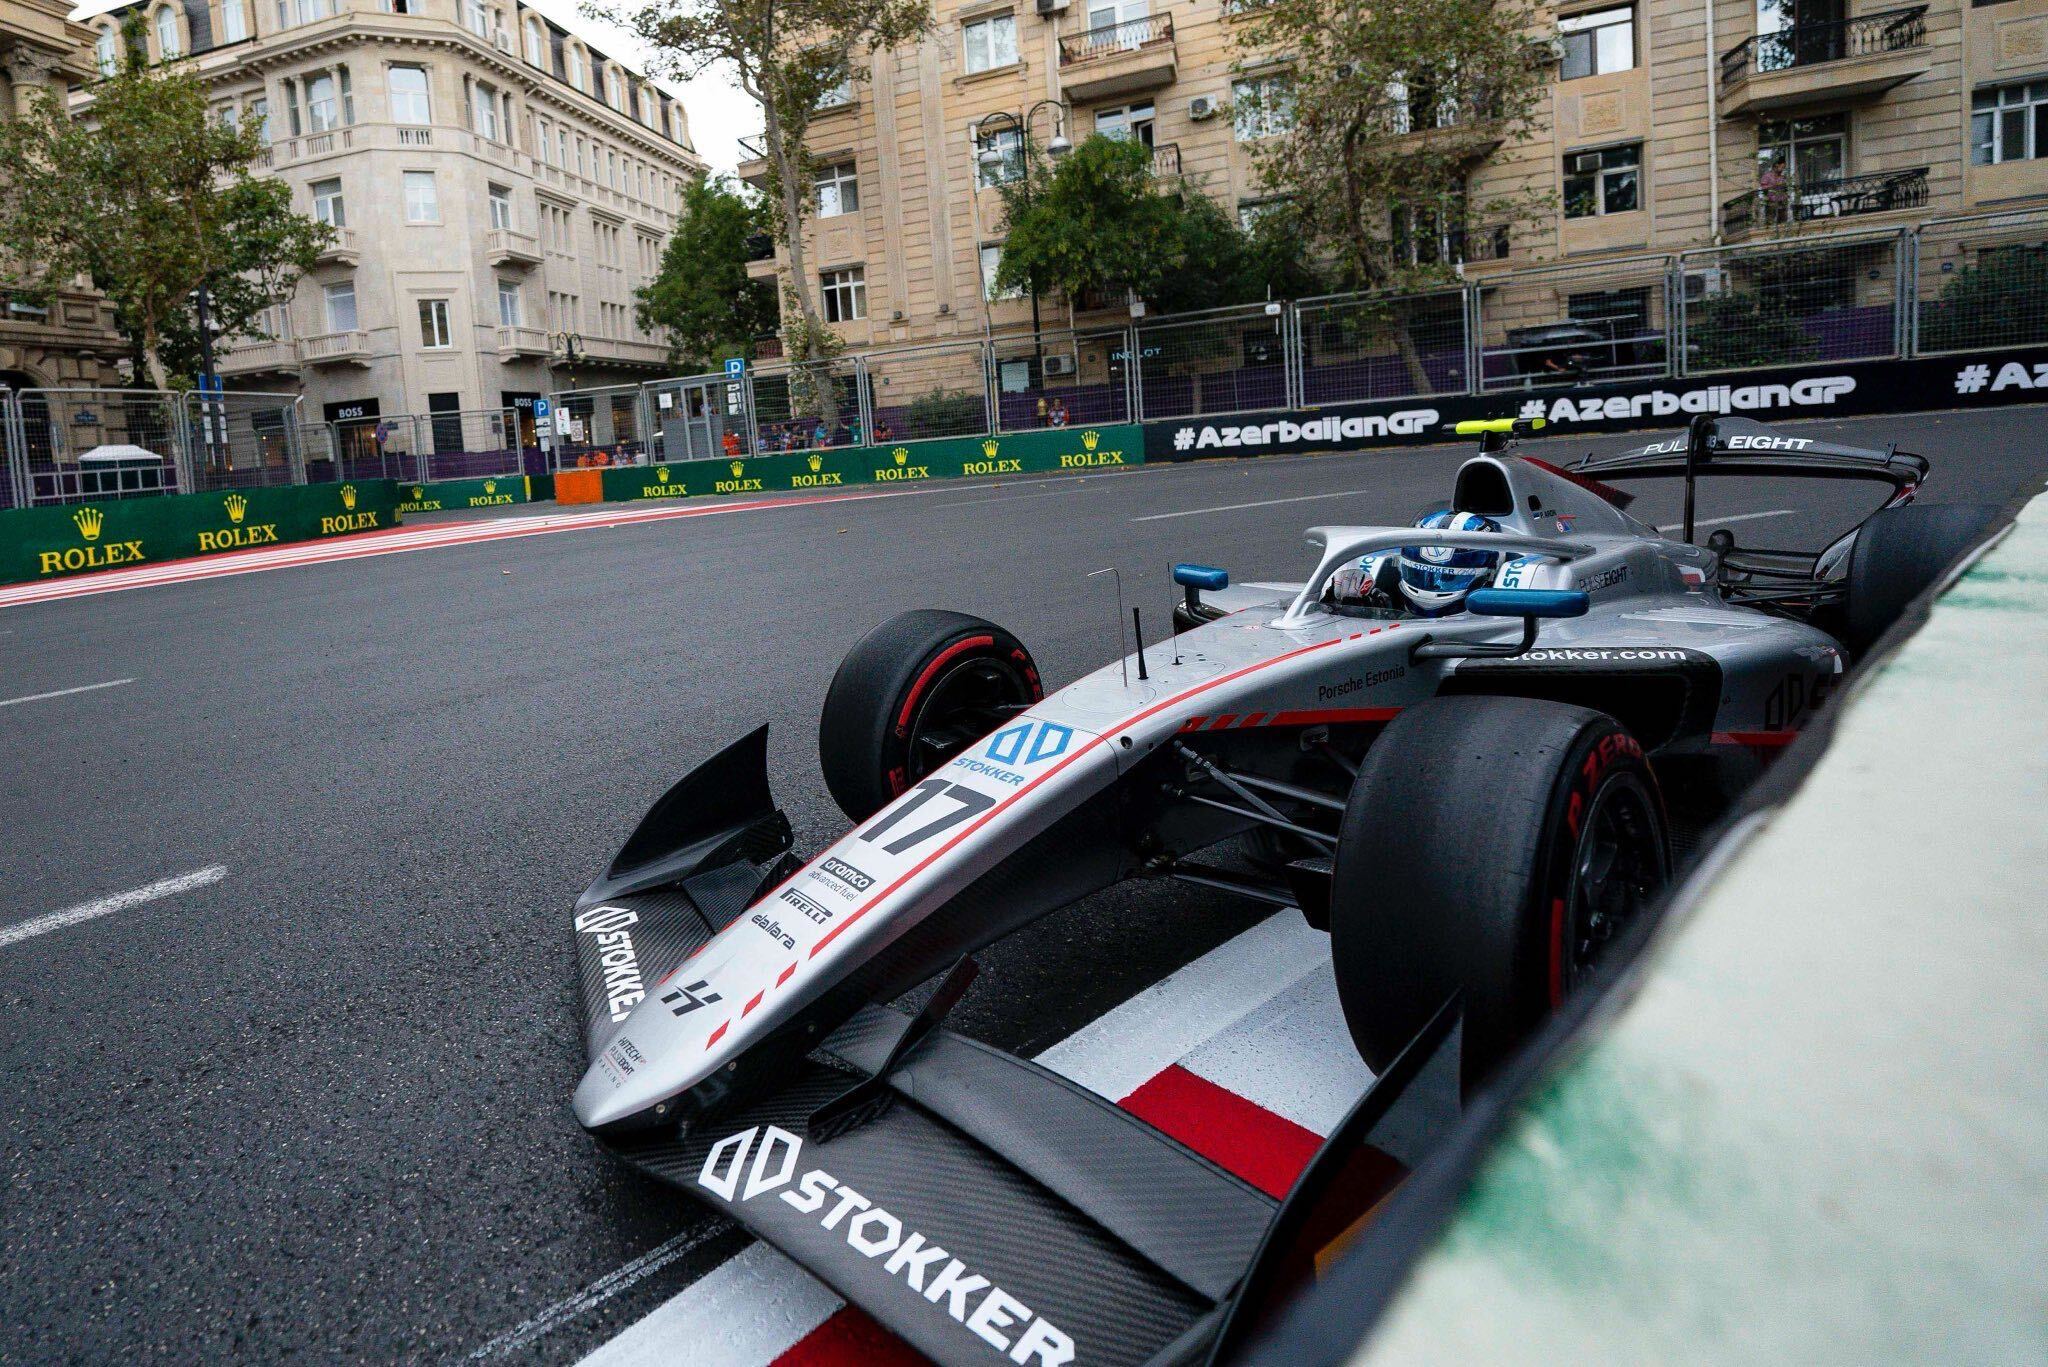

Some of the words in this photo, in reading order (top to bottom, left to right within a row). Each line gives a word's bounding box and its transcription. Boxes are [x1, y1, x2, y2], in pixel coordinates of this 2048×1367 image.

[514, 398, 532, 407] BOSS
[1519, 376, 1857, 423] #AzerbaijanGP
[338, 406, 363, 418] BOSS
[1174, 409, 1439, 450] #AzerbaijanGP
[1727, 435, 1813, 450] EIGHT
[963, 459, 1022, 475] ROLEX
[1060, 450, 1124, 468] ROLEX
[715, 478, 763, 493] ROLEX
[792, 472, 843, 487] ROLEX
[875, 466, 930, 481] ROLEX
[469, 494, 513, 507] ROLEX
[643, 484, 687, 497] ROLEX
[400, 500, 442, 512] ROLEX
[321, 511, 378, 534] ROLEX
[198, 523, 278, 551] ROLEX
[39, 540, 145, 574] ROLEX
[1414, 563, 1455, 575] STOKKER
[1319, 677, 1363, 701] Porsche
[1365, 664, 1405, 687] Estonia
[953, 757, 1025, 787] STOKKER
[858, 778, 996, 856] 17
[808, 870, 844, 893] advanced
[838, 884, 859, 902] fuel
[824, 859, 870, 889] aramco
[780, 887, 833, 925] PIRELLI
[751, 914, 796, 950] dallara
[618, 1036, 642, 1062] HITECH
[779, 1168, 1076, 1367] STOKKER
